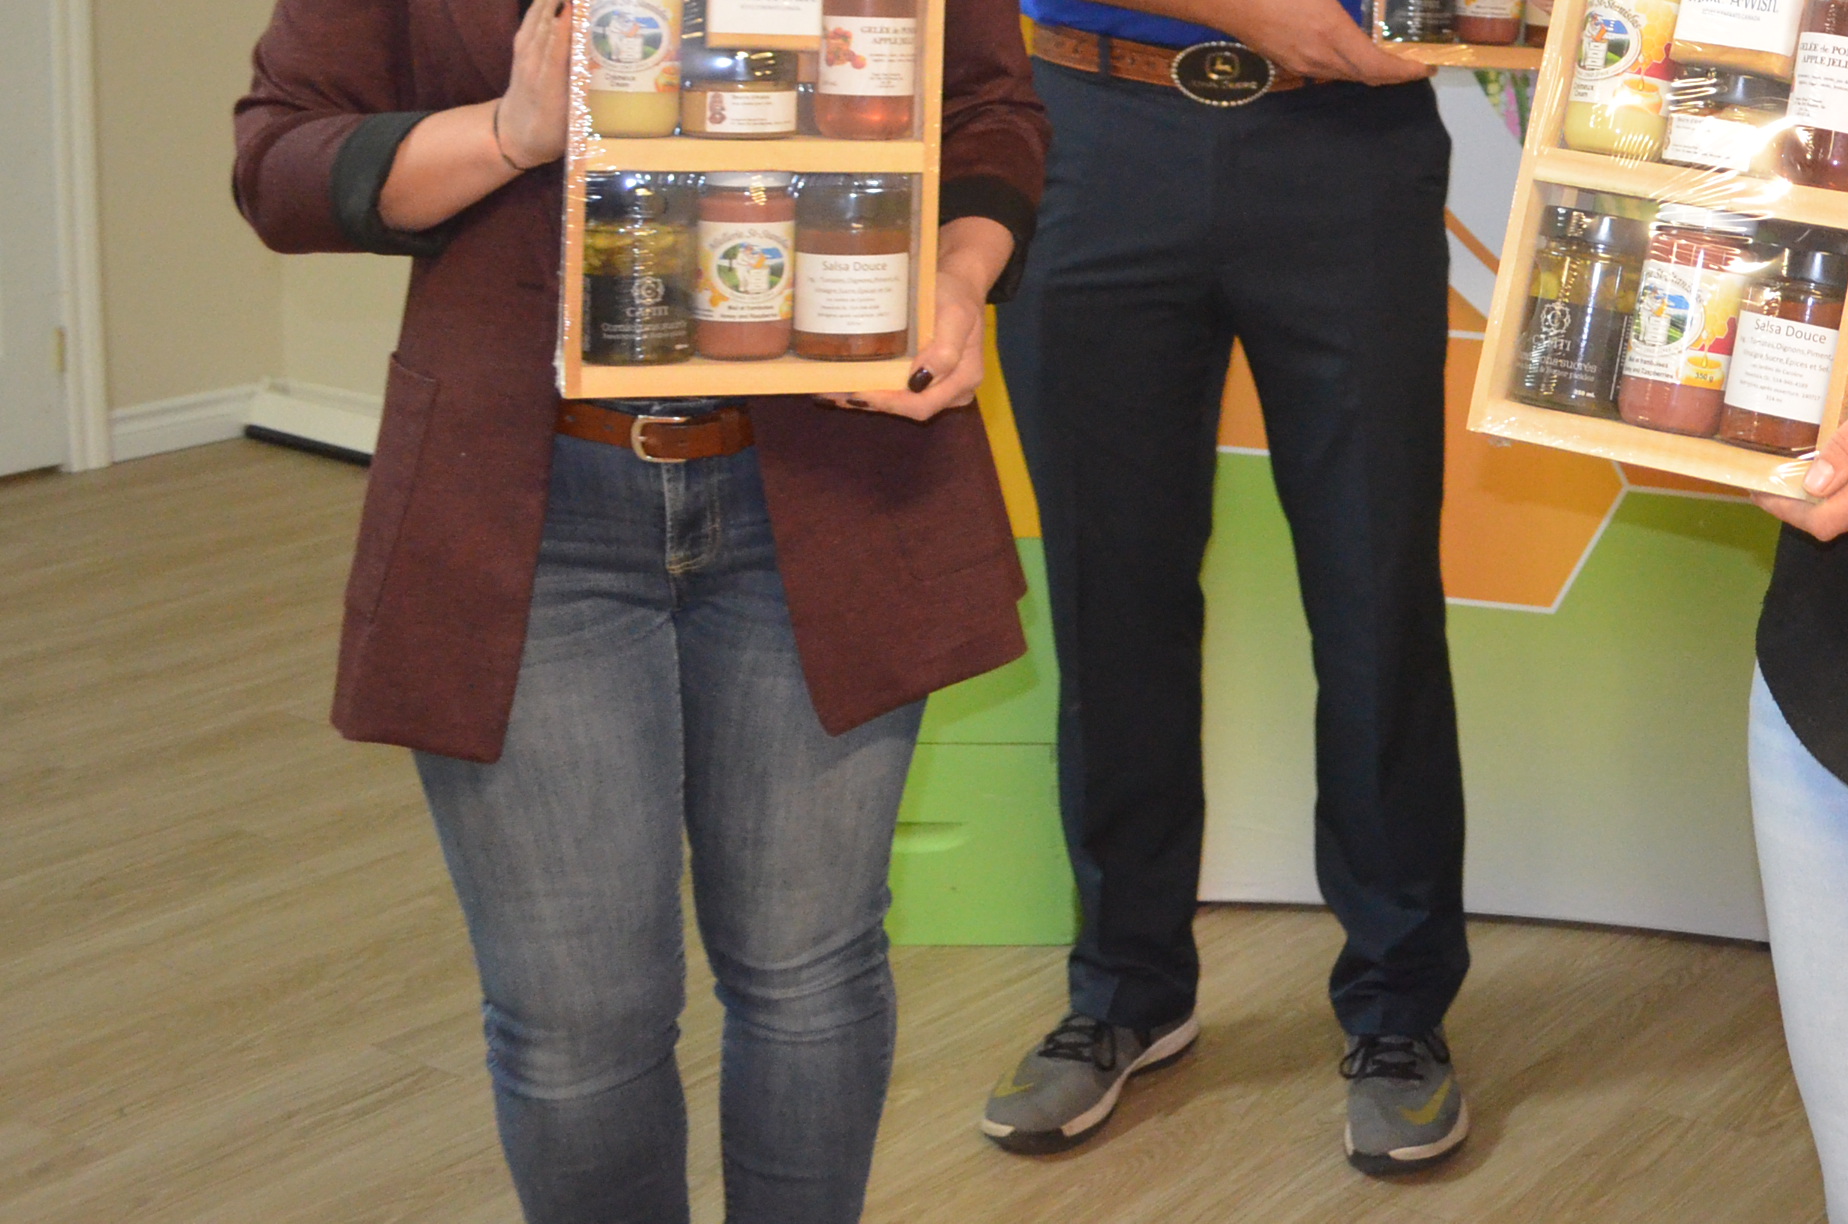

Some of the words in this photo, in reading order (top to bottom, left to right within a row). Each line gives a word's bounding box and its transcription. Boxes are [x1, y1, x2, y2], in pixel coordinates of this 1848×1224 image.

[1801, 55, 1826, 66] APPLE
[822, 261, 850, 272] Salsa
[852, 261, 889, 272] Douce
[1754, 318, 1782, 335] Salsa
[1785, 325, 1827, 344] Douce
[1695, 370, 1708, 381] 350
